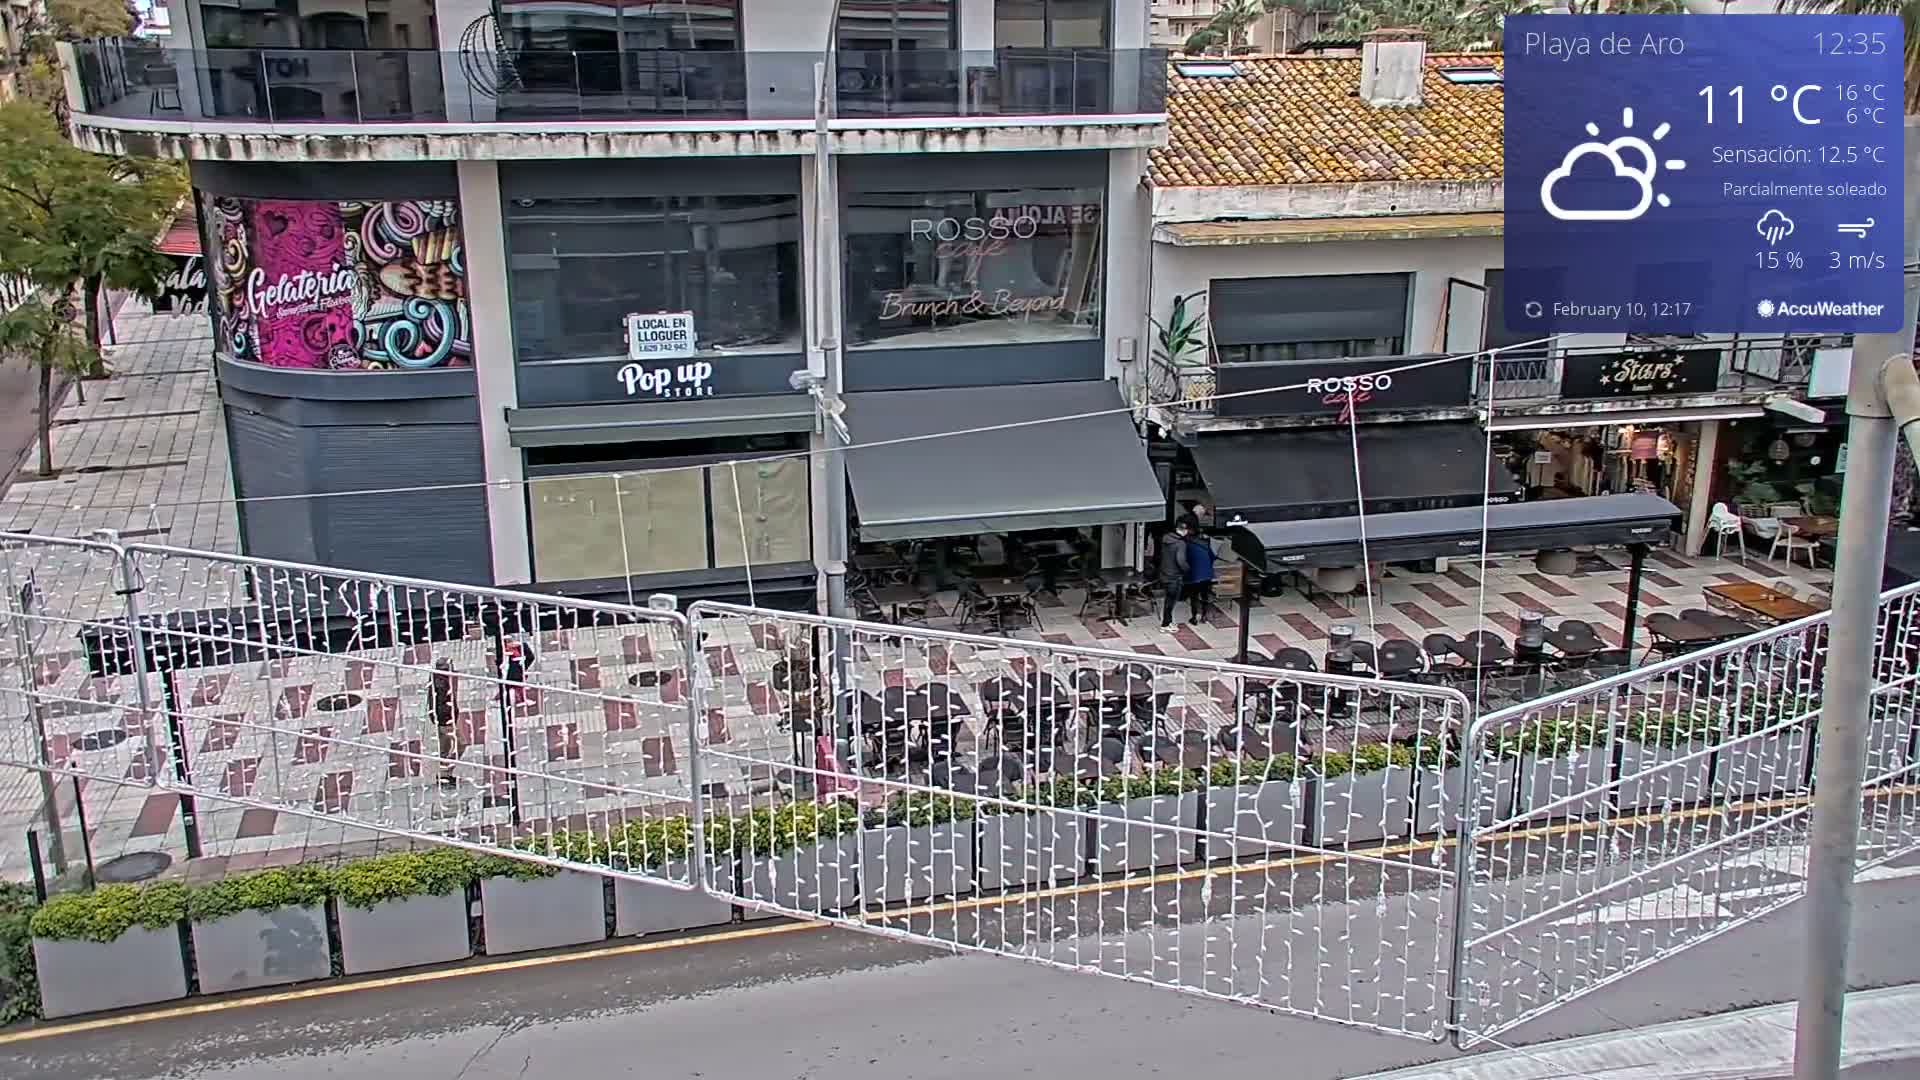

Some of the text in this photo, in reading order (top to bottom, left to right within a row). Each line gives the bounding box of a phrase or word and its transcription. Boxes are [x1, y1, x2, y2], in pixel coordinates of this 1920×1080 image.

[910, 215, 1037, 242] ROSSO
[879, 288, 1069, 322] Brunch & Beyond
[637, 318, 686, 330] LOCAL EN
[638, 330, 687, 342] LLOGUER
[617, 361, 712, 395] Pop up
[1613, 358, 1675, 383] Stars
[664, 387, 713, 398] STORE
[1307, 374, 1392, 394] ROSSO
